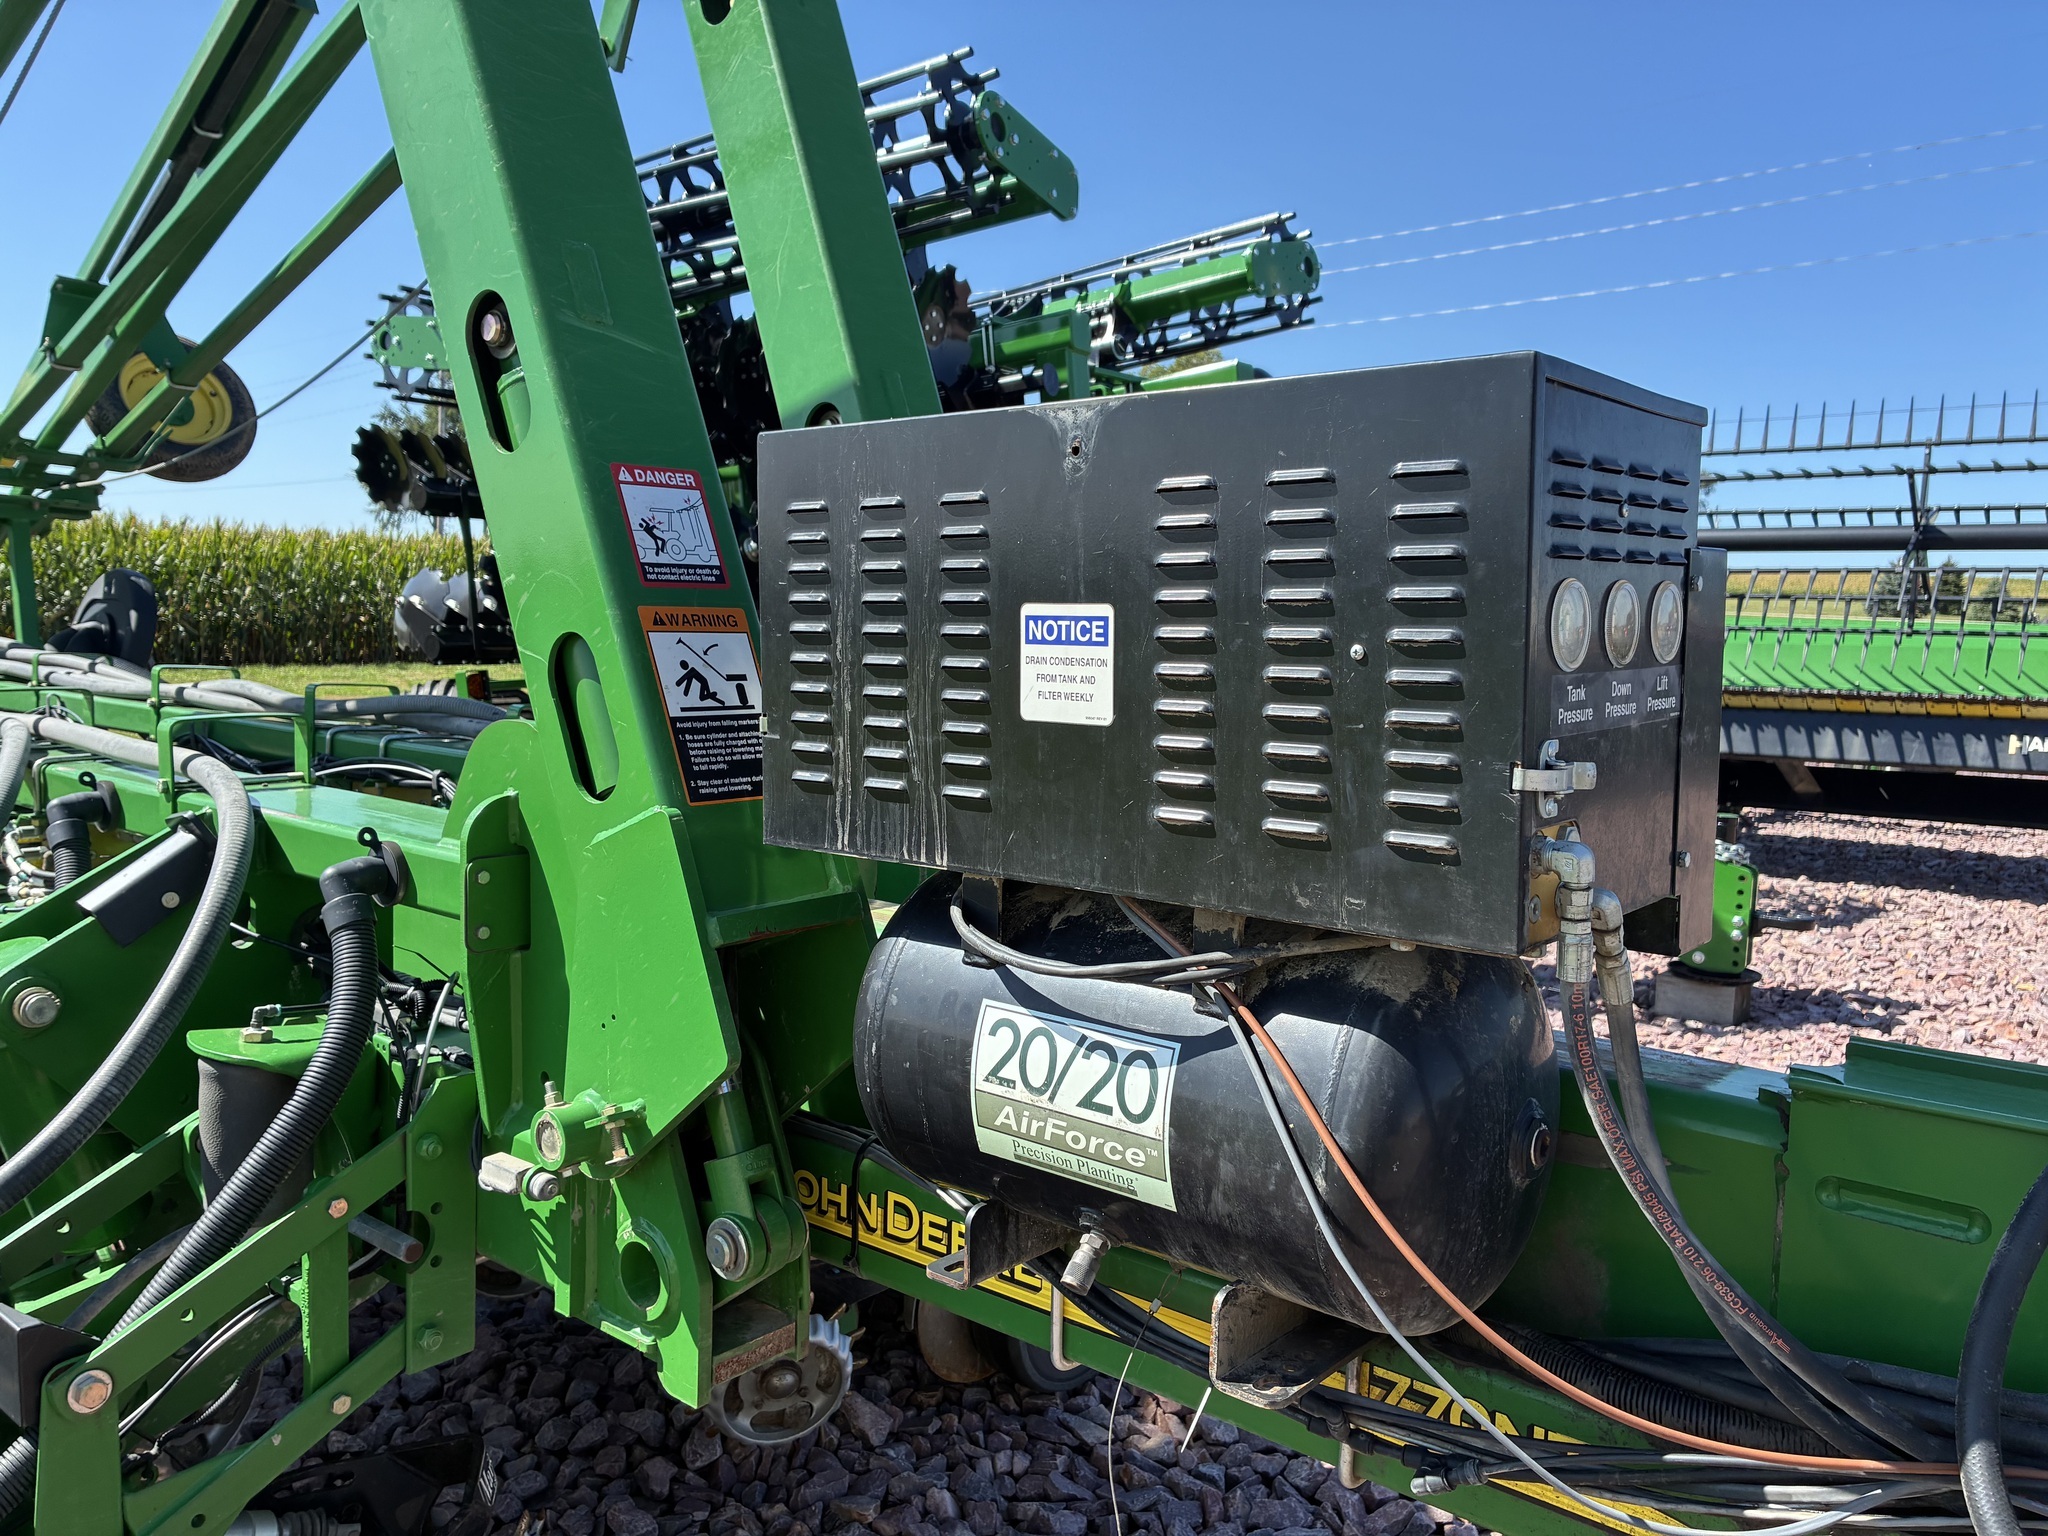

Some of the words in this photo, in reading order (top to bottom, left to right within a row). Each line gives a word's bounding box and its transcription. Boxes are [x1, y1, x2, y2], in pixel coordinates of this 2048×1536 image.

[633, 469, 696, 487] DANGER
[671, 567, 687, 575] injury
[665, 613, 738, 628] WARNING
[1028, 619, 1105, 642] NOTICE
[1025, 656, 1048, 666] DRAIN
[1049, 656, 1108, 668] CONDENSATION
[1036, 673, 1057, 683] FROM
[1058, 674, 1078, 684] TANK
[1079, 675, 1096, 685] AND
[1656, 675, 1669, 691] Lift
[1038, 690, 1062, 701] FILTER
[1063, 691, 1094, 703] WEEKLY
[1567, 684, 1587, 702] Tank
[1611, 681, 1632, 697] Down
[1605, 702, 1637, 718] Pressure
[1647, 696, 1676, 712] Pressure
[1558, 707, 1593, 725] Pressure
[707, 732, 728, 740] cylinder
[2008, 734, 2048, 755] HA
[982, 1018, 1159, 1125] 20/20
[1596, 1101, 1621, 1139] OPER
[1011, 1139, 1073, 1170] Precision
[1613, 1139, 1637, 1170] MAX
[1629, 1170, 1649, 1192] PSI
[793, 1169, 878, 1231] OHN
[1683, 1246, 1705, 1268] 210
[1701, 1266, 1749, 1315] FC639-06
[1749, 1312, 1787, 1349] Aeroquip
